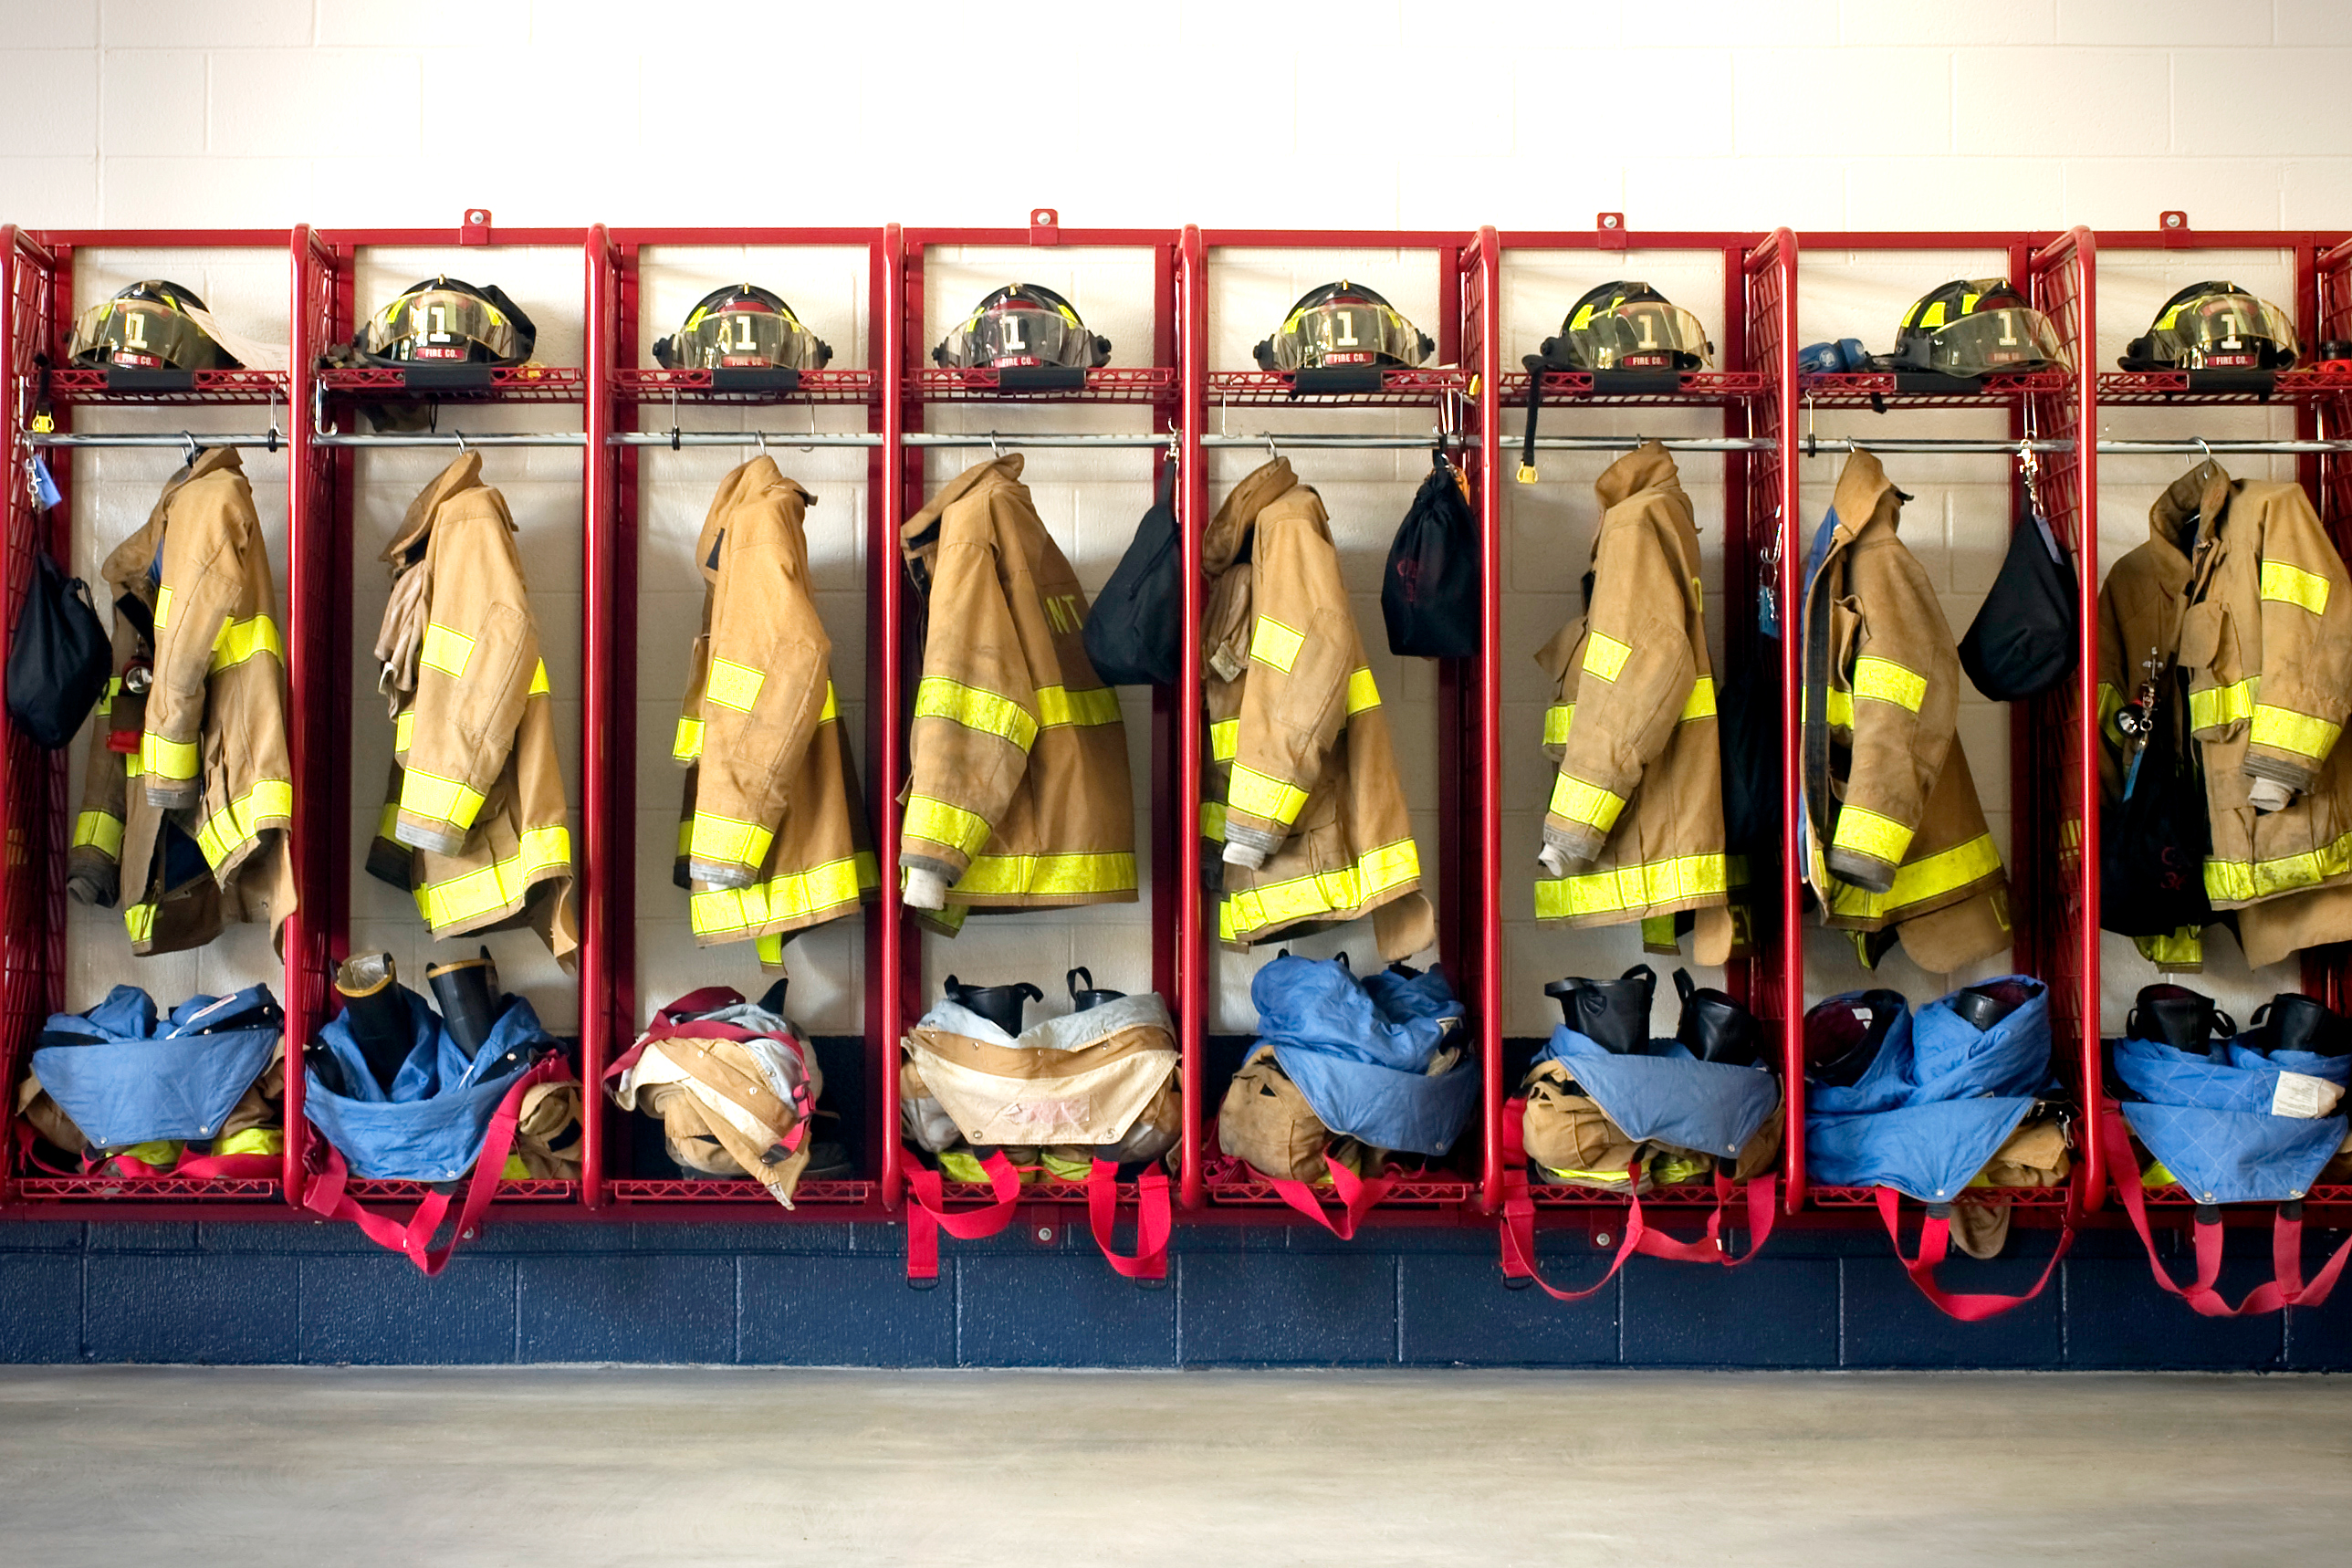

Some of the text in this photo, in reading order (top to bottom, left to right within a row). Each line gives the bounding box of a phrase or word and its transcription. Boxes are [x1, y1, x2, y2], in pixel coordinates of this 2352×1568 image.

[126, 313, 148, 349] 1
[429, 307, 451, 343] 1
[735, 316, 757, 350] 1
[1002, 315, 1026, 350] 1
[1337, 311, 1358, 346] 1
[1637, 315, 1657, 349] 1
[1998, 311, 2017, 346] 1
[2221, 314, 2242, 350] 1
[425, 349, 443, 359] FIRE
[1001, 357, 1019, 366] FIRE
[1333, 353, 1351, 363] FIRE
[1632, 357, 1649, 365] FIRE
[2216, 356, 2233, 365] FIRE
[1042, 594, 1083, 634] NT
